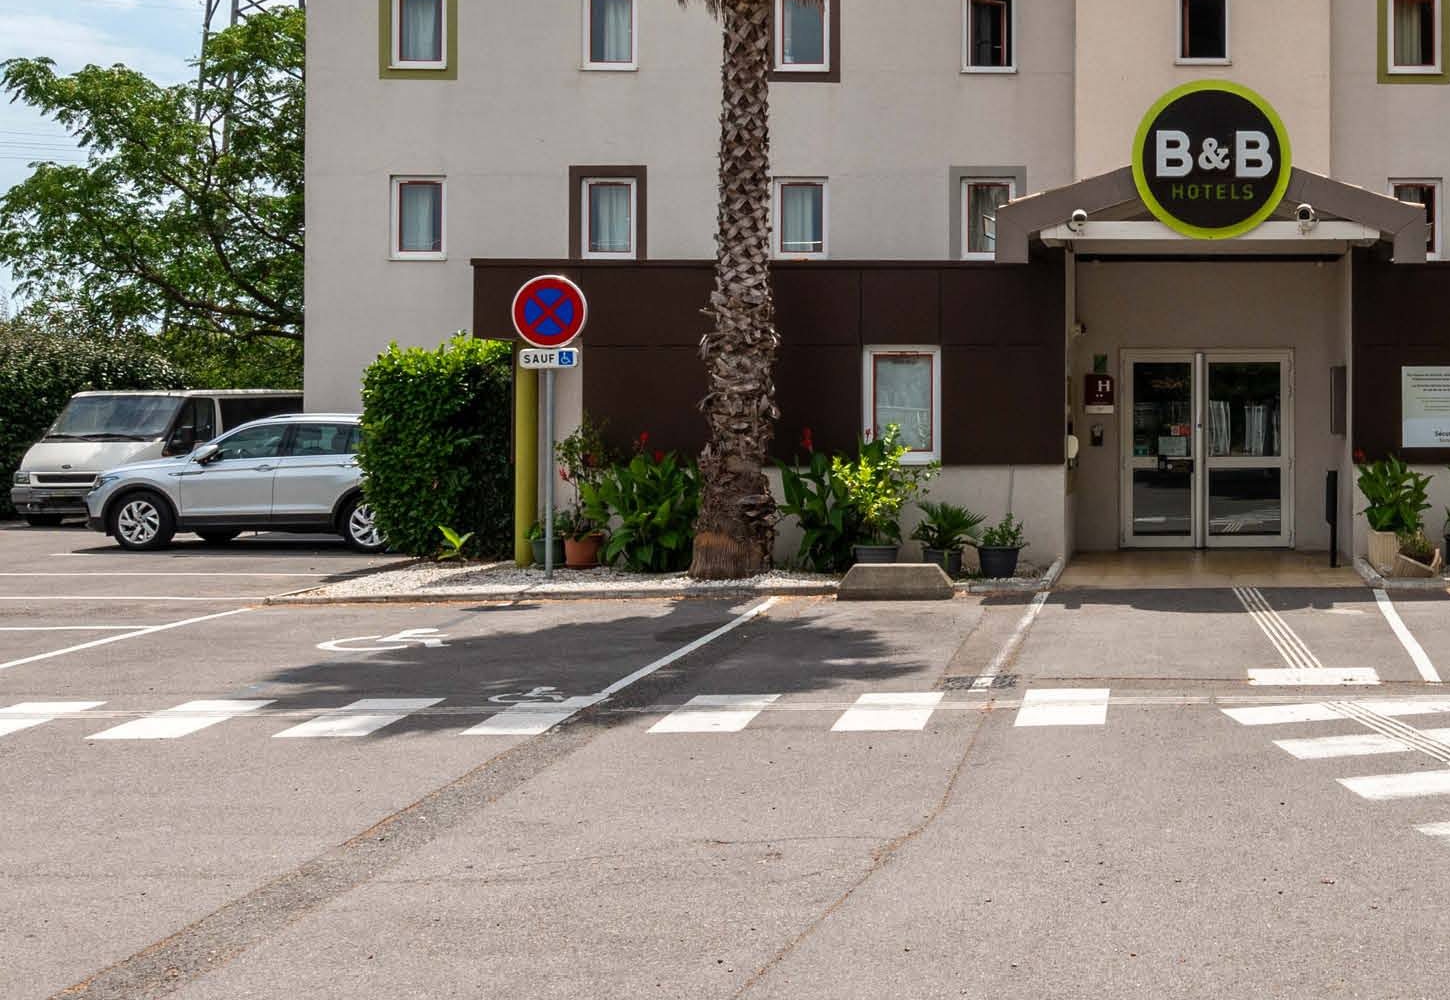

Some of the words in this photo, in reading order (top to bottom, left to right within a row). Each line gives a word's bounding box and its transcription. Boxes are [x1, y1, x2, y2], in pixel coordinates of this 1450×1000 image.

[1156, 130, 1273, 177] B&B
[1171, 183, 1254, 200] HOTELS
[523, 353, 555, 364] SAUF
[1098, 380, 1111, 392] H
